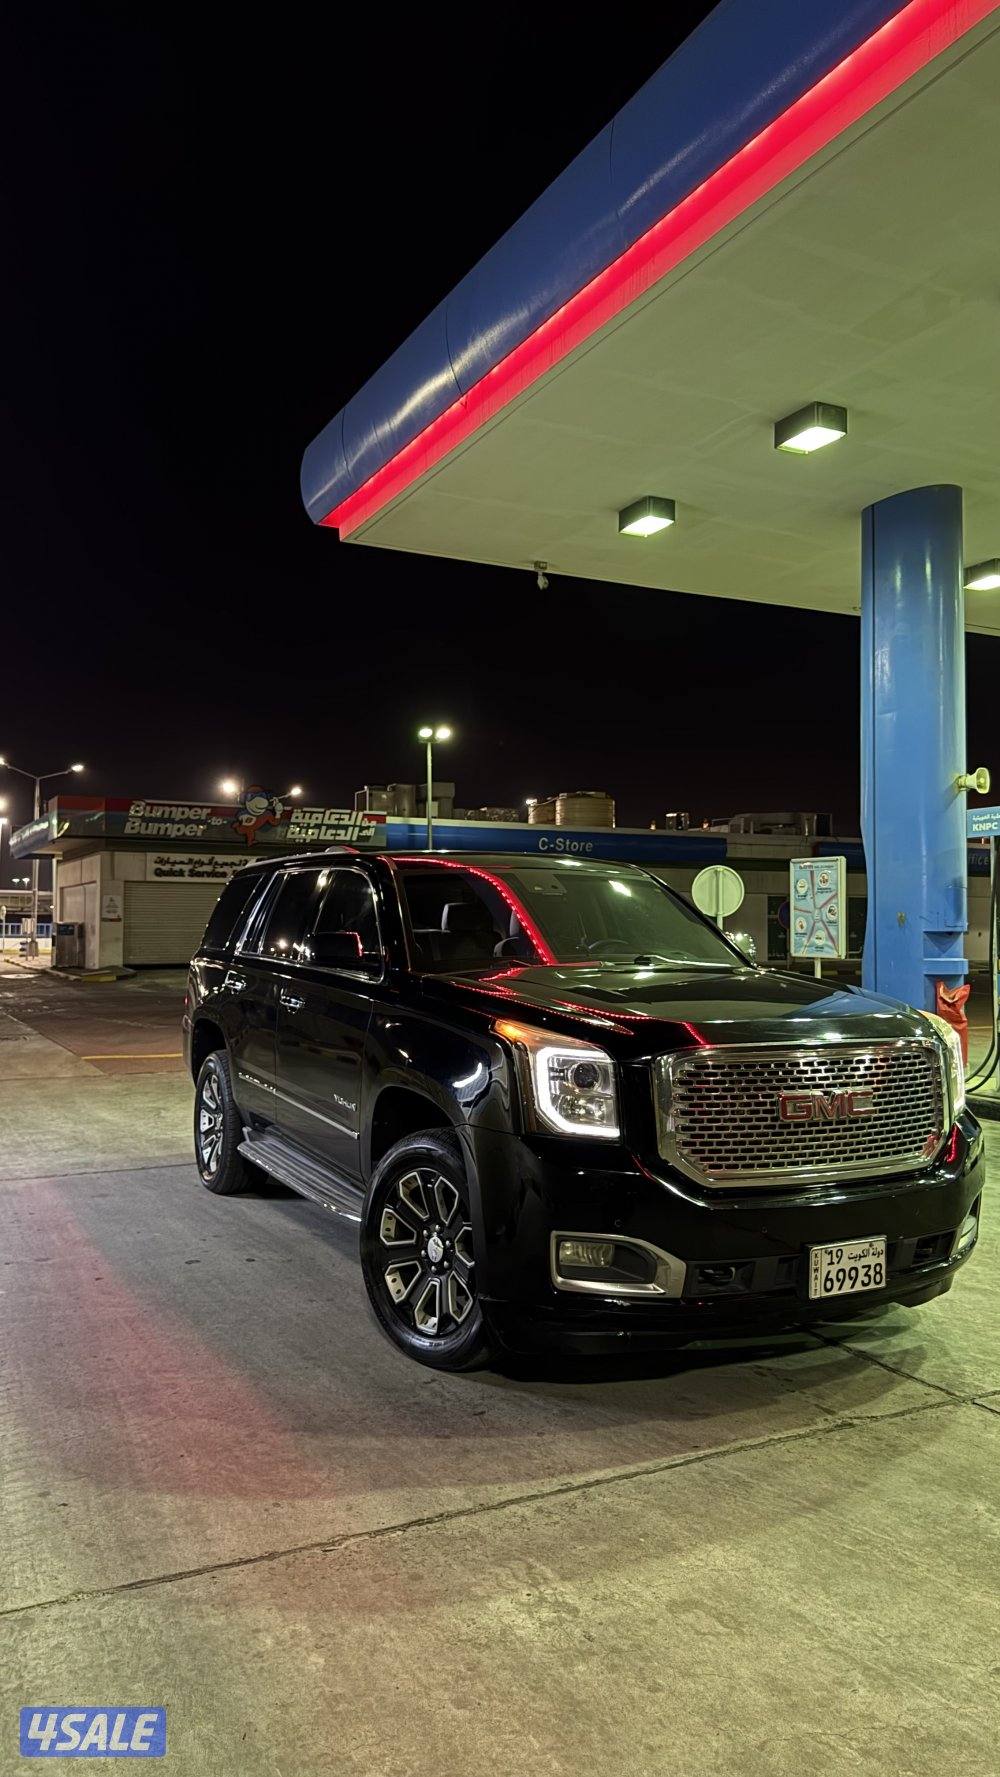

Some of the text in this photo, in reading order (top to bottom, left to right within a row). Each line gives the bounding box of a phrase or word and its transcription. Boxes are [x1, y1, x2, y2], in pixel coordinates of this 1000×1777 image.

[128, 800, 211, 820] Bumper
[291, 808, 364, 827] الدعامية
[123, 818, 207, 838] Bumper
[286, 824, 360, 843] الدعامية
[972, 822, 998, 831] KNPC
[538, 837, 594, 852] C-Store
[154, 867, 186, 878] Quick
[187, 867, 228, 878] Service
[777, 1087, 876, 1121] GMC
[827, 1248, 844, 1266] 19
[847, 1247, 884, 1262] دولة الكويت
[823, 1262, 883, 1293] 69938
